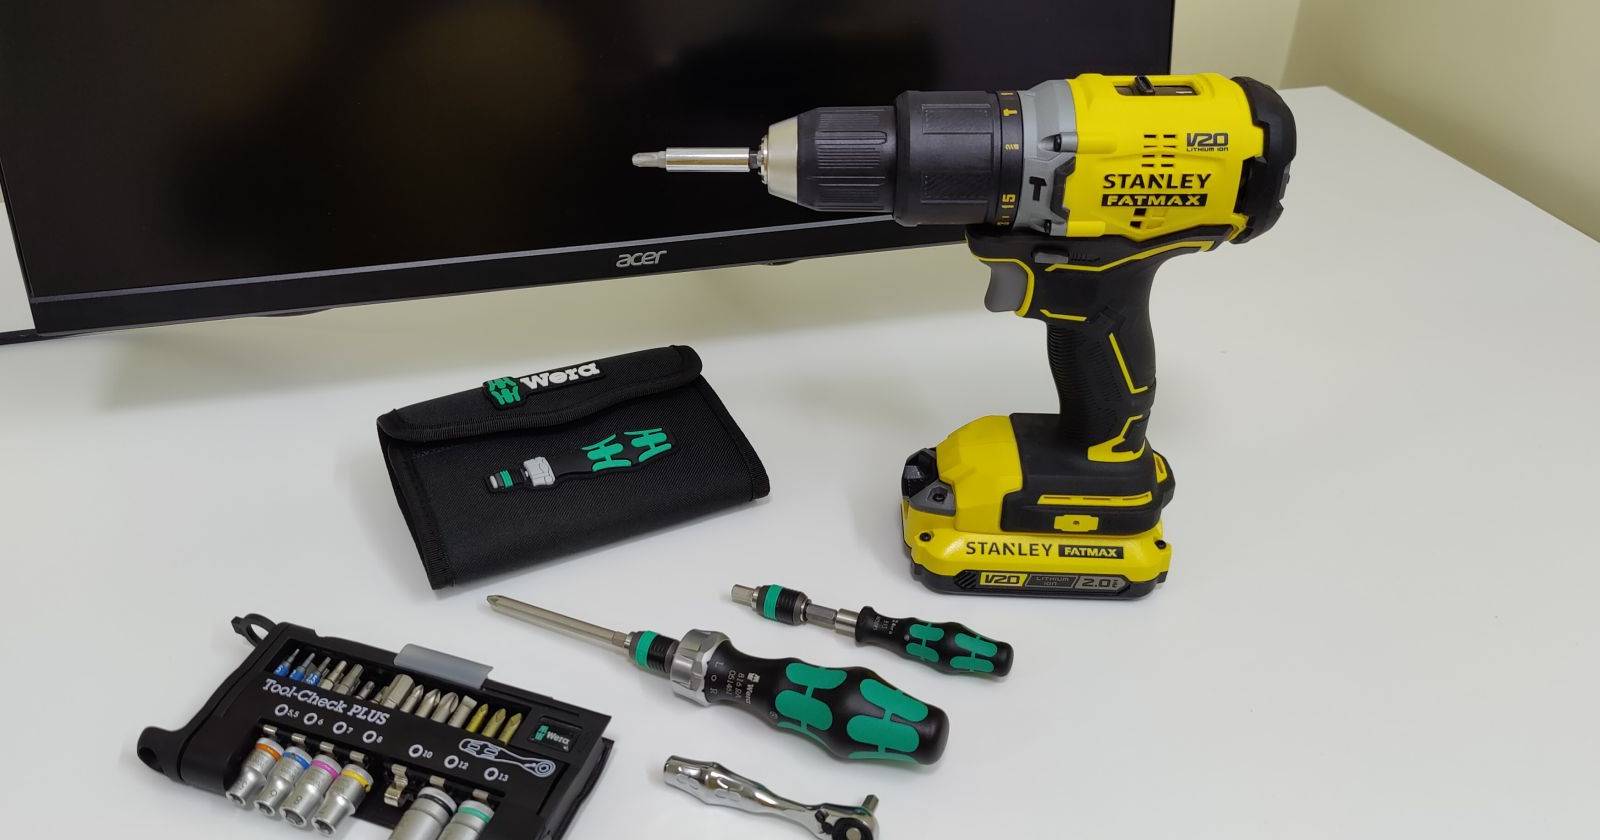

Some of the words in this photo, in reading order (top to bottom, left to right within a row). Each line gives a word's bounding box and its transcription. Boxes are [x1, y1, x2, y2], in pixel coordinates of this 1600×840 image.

[1186, 132, 1229, 147] V20
[1102, 173, 1212, 190] STANLEY
[1106, 194, 1202, 206] FATMAX
[615, 250, 668, 268] acer
[519, 361, 601, 390] Wera
[965, 541, 1053, 557] STANLEY
[1063, 546, 1118, 558] FATMAX
[983, 574, 1021, 585] V20
[1081, 578, 1111, 588] 2.0
[262, 678, 348, 714] Tool-Check
[347, 703, 391, 726] PLUS
[317, 718, 324, 726] 6
[346, 726, 354, 734] 7
[376, 735, 384, 744] 8
[545, 731, 571, 746] Wera
[422, 749, 434, 759] 10
[457, 759, 469, 770] 12
[498, 772, 509, 782] 13
